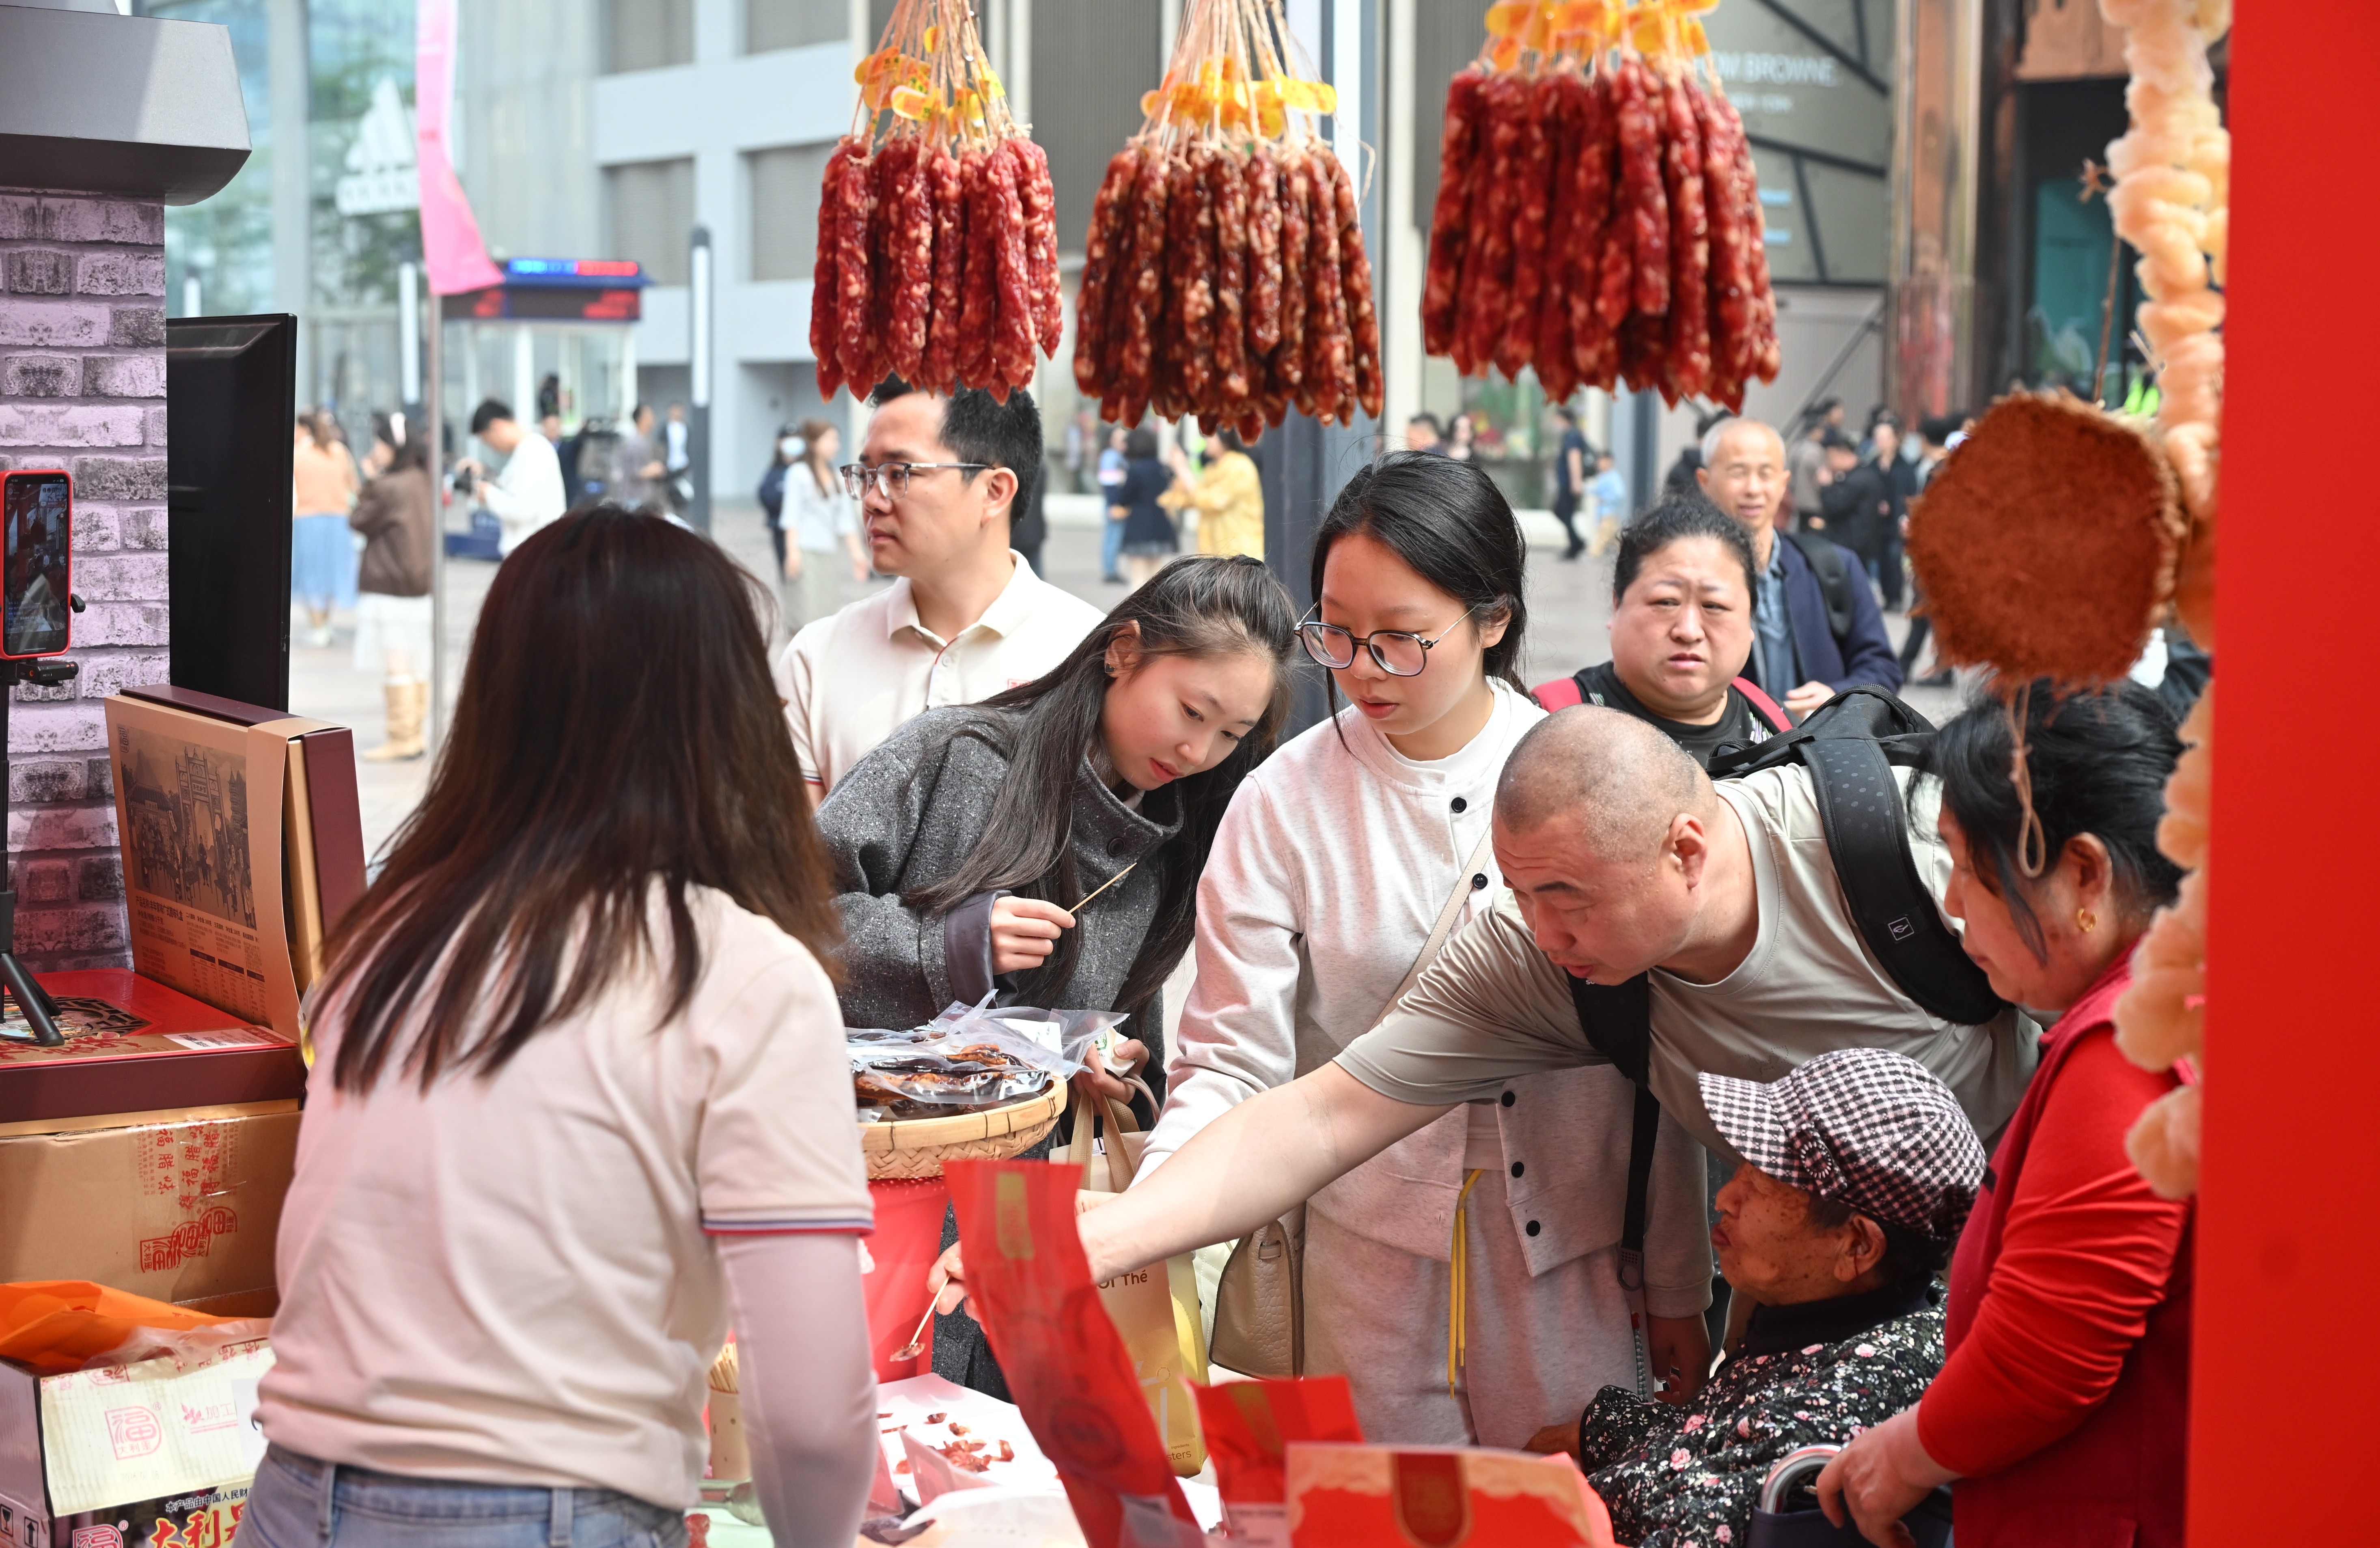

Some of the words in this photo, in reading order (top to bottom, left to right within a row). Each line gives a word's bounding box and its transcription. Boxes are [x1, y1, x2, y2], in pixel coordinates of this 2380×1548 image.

[200, 1122, 220, 1196] 得福腊
[1121, 1269, 1148, 1286] Thé
[166, 1487, 251, 1513] 本产品由中国人民财
